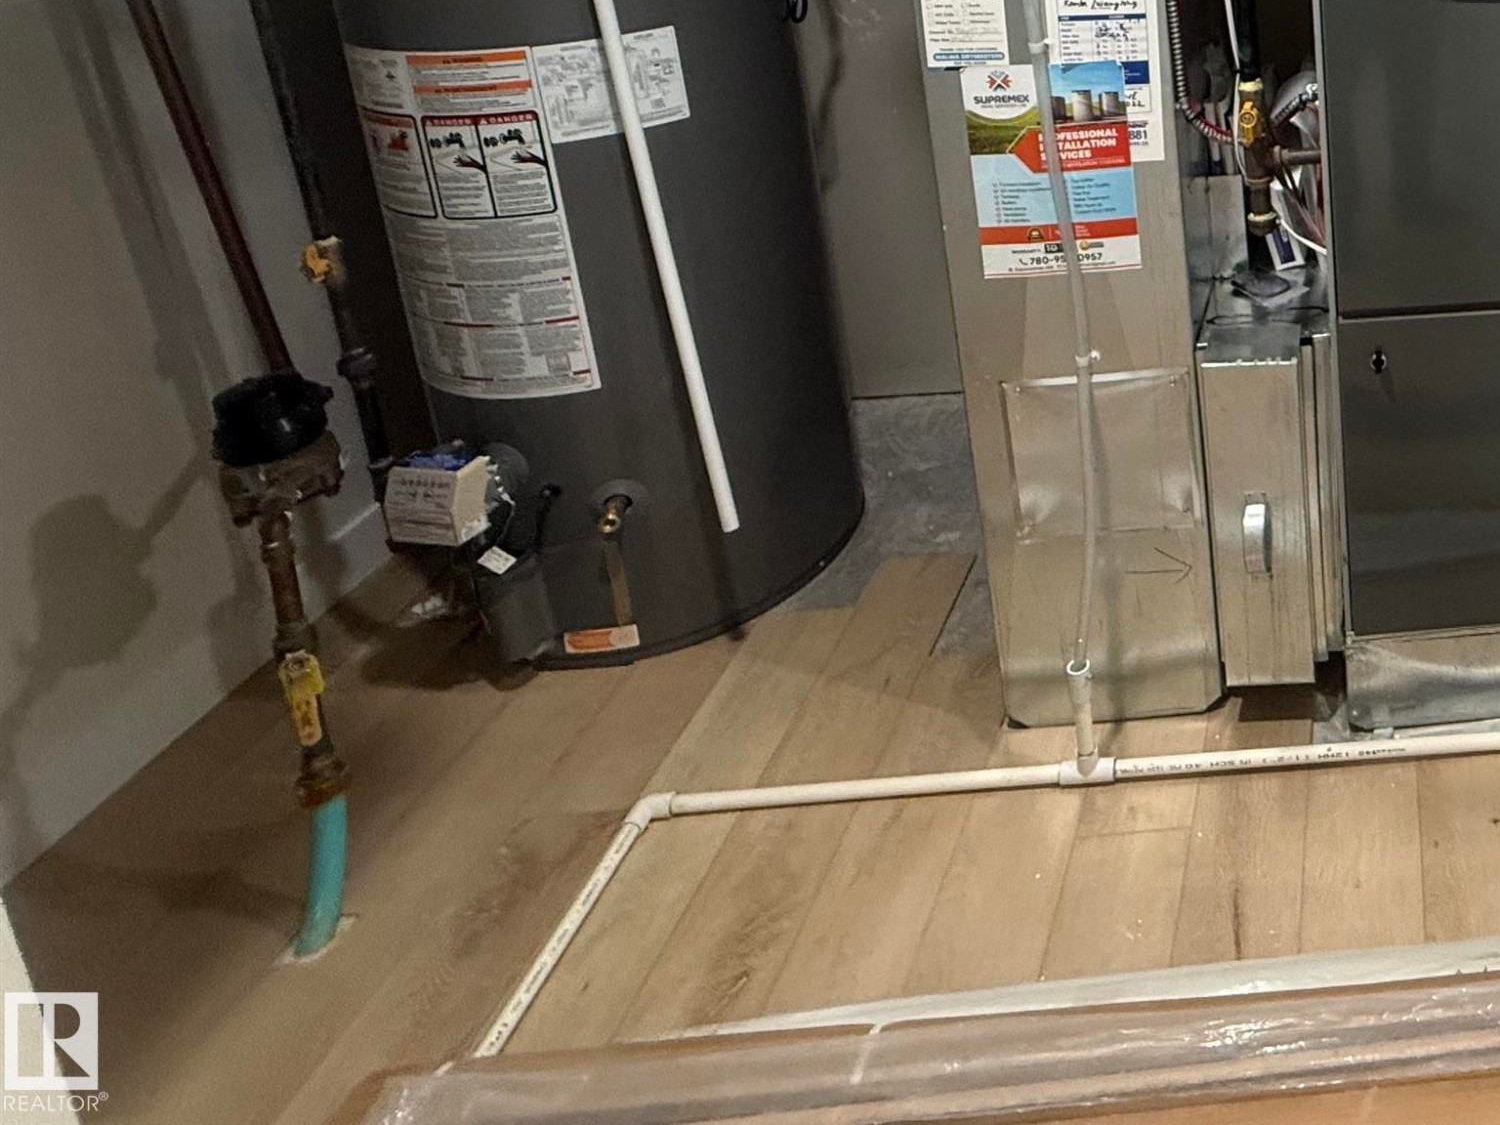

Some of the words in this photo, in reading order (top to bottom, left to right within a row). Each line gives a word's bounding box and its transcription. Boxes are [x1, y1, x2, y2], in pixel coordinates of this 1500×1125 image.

[973, 94, 1030, 104] SUPREMEX
[489, 114, 534, 123] DANGER
[1038, 128, 1119, 142] OFESSIONAL
[1039, 138, 1117, 151] ITALLATION
[1041, 149, 1092, 161] SVICES
[1030, 253, 1103, 265] 780-950957
